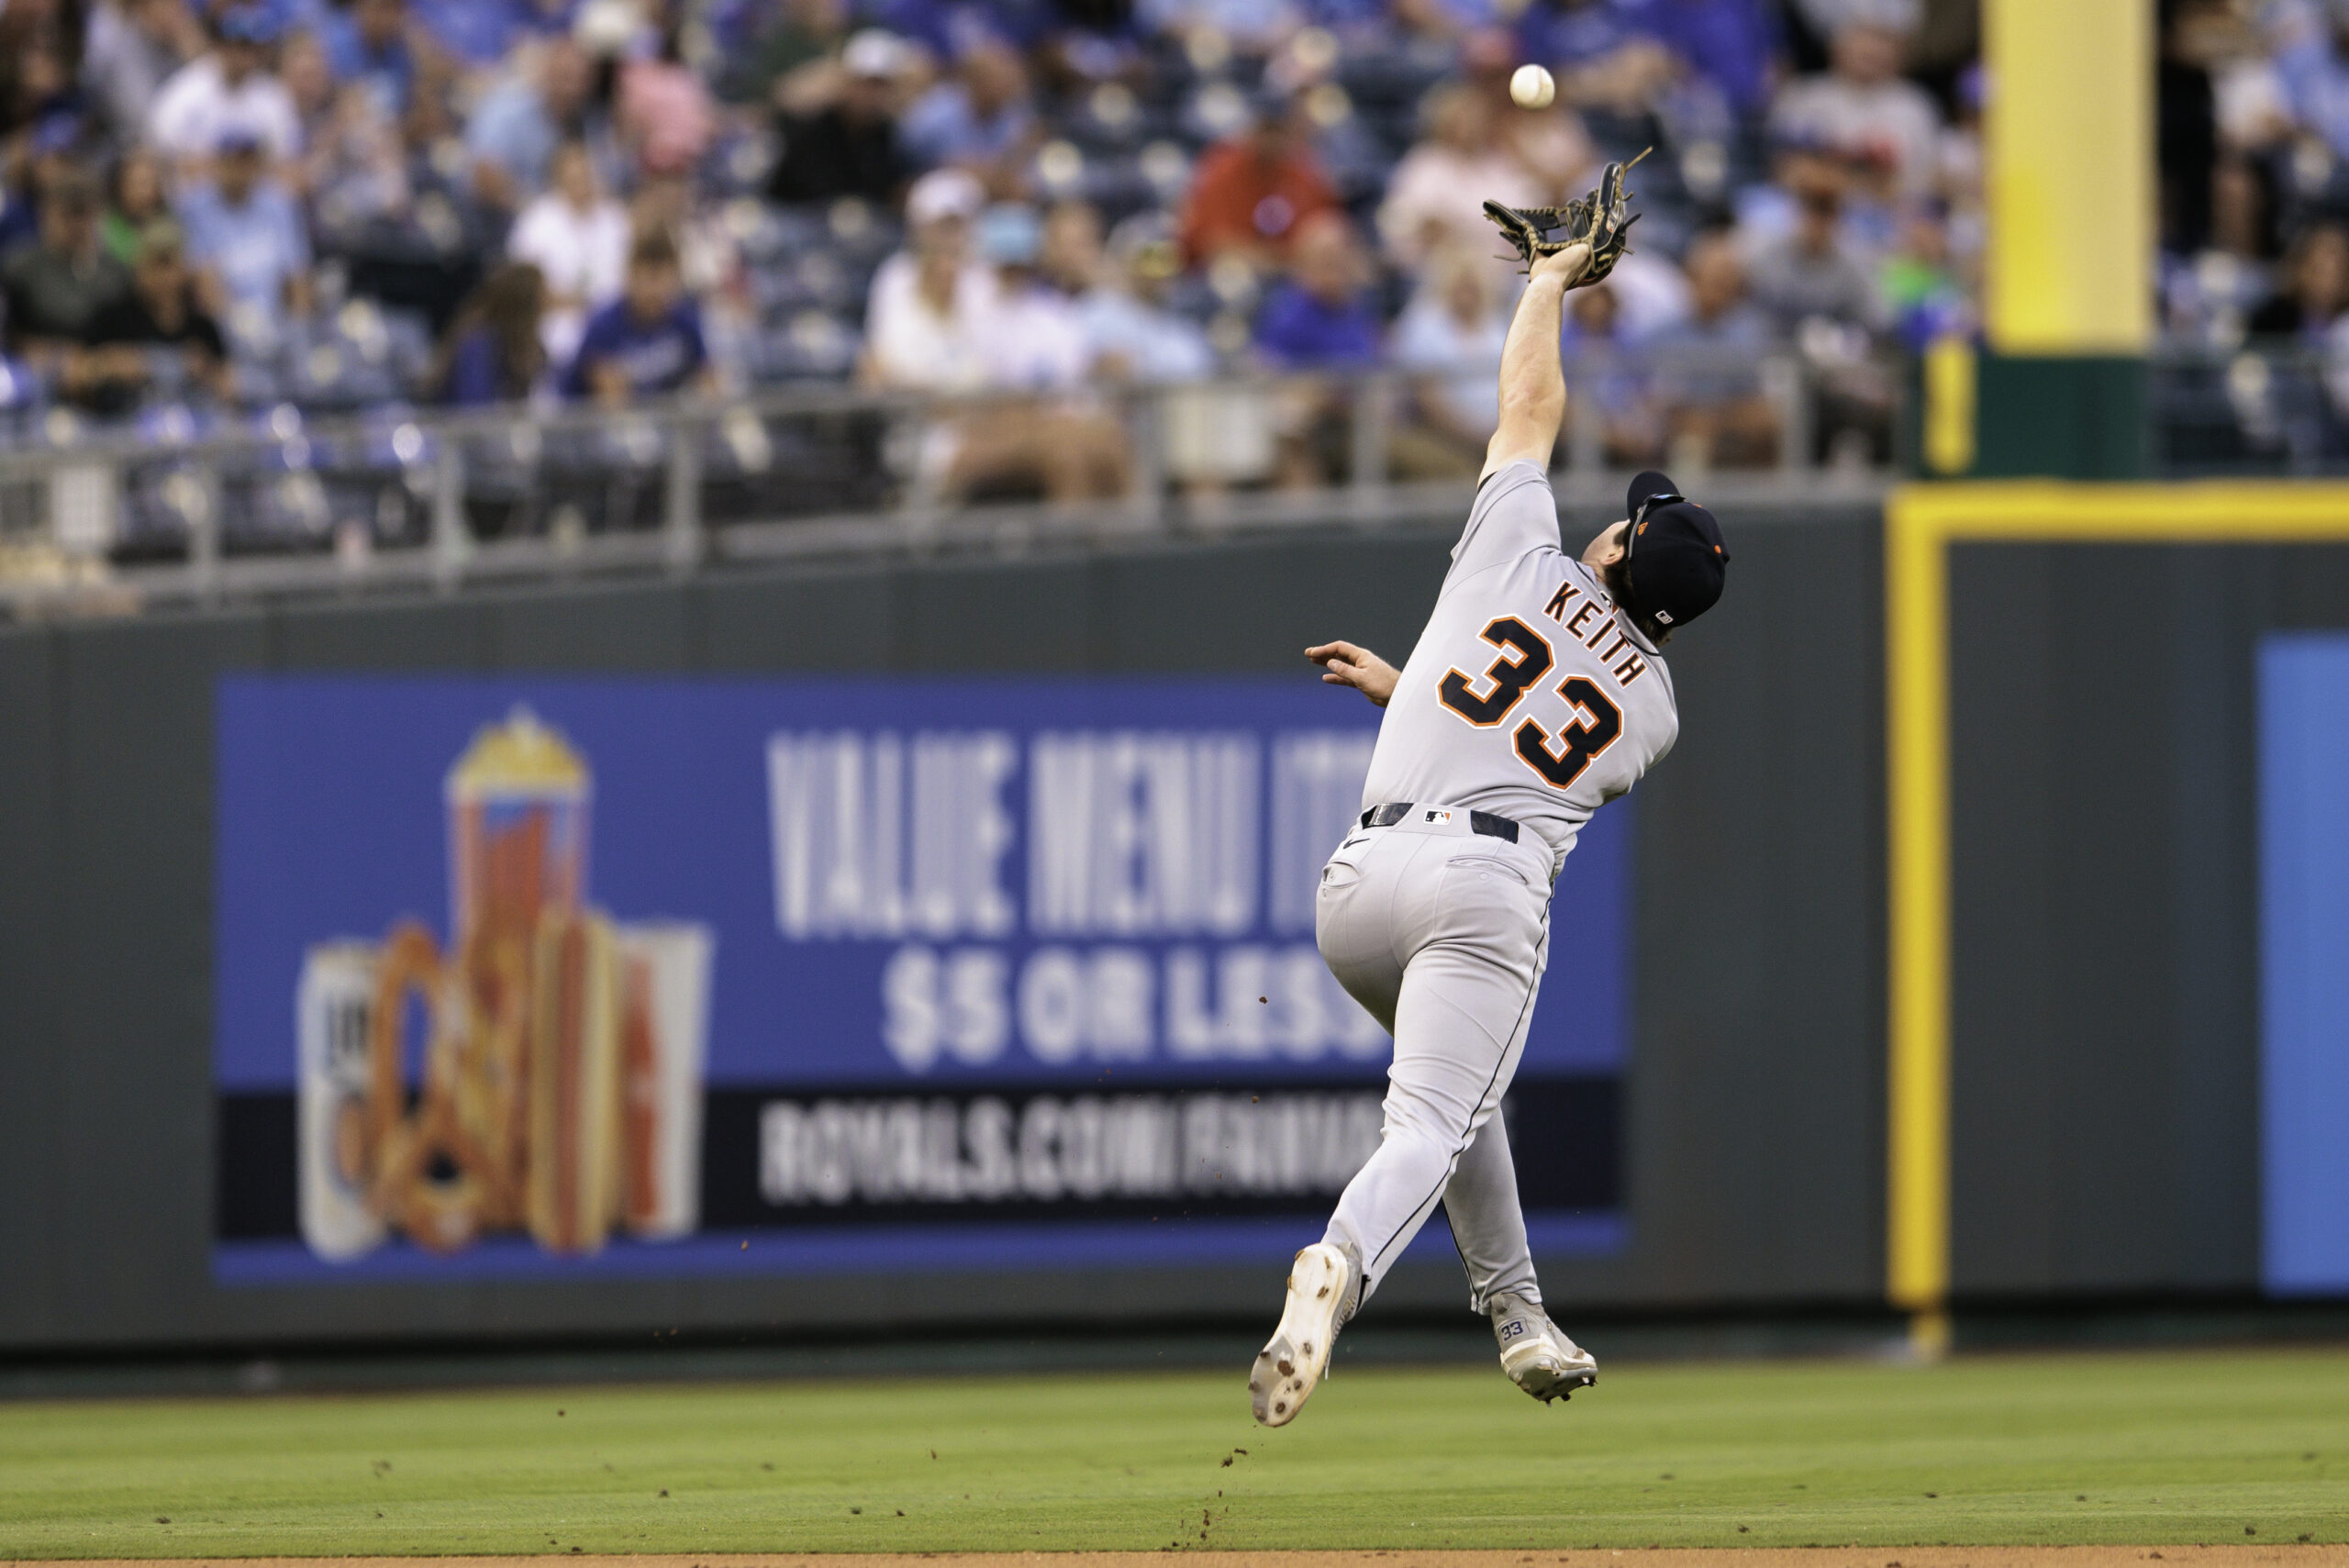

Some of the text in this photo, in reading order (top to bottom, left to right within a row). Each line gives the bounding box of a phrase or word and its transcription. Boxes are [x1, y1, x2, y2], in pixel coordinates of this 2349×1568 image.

[1542, 579, 1648, 689] KEITH
[1436, 613, 1624, 792] 33
[766, 731, 1017, 939] VALUE
[1027, 730, 1264, 935] MENU
[883, 945, 1010, 1072] $5
[1019, 945, 1155, 1064] OR
[1501, 1321, 1523, 1341] 33
